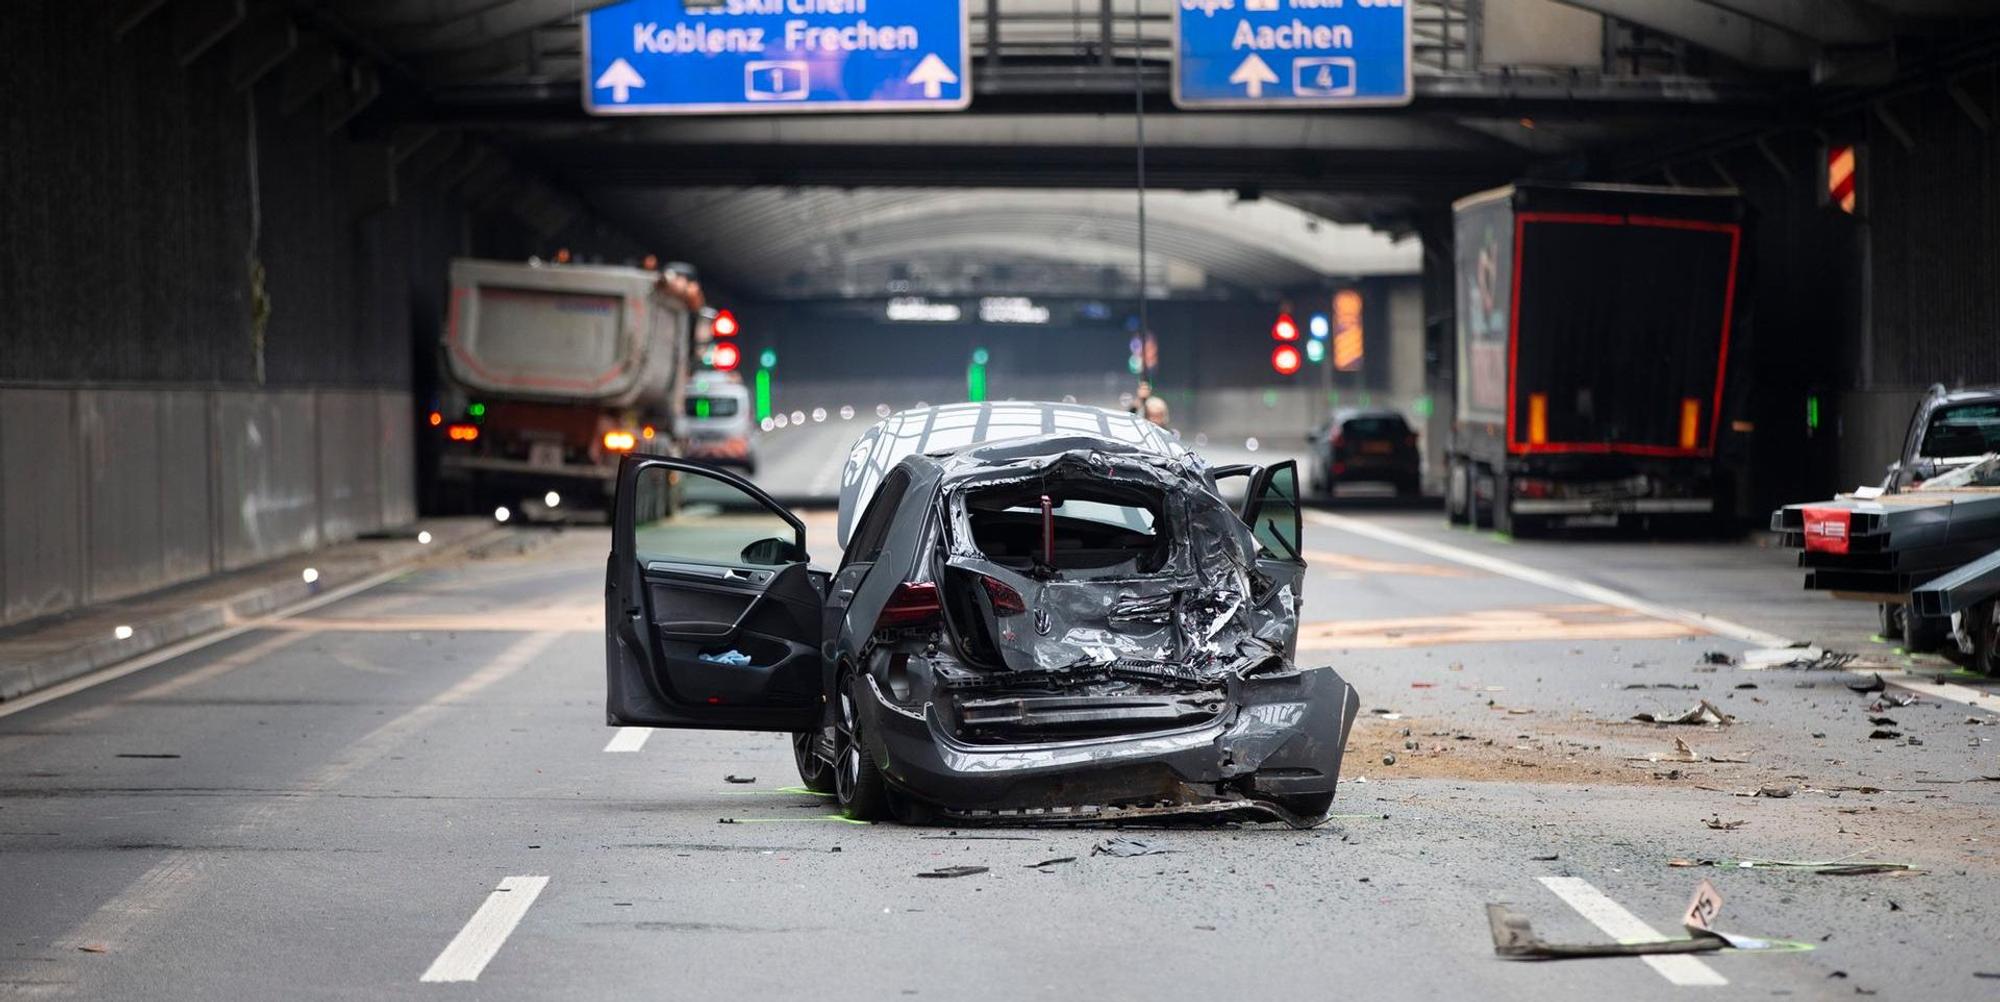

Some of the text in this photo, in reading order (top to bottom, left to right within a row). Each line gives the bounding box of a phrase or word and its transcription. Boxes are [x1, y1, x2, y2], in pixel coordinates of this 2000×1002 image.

[633, 20, 918, 53] Koblenz Frechen
[1232, 19, 1353, 50] Aachen
[770, 68, 784, 94] 1
[1315, 65, 1333, 90] 4
[1690, 891, 1713, 928] 75
